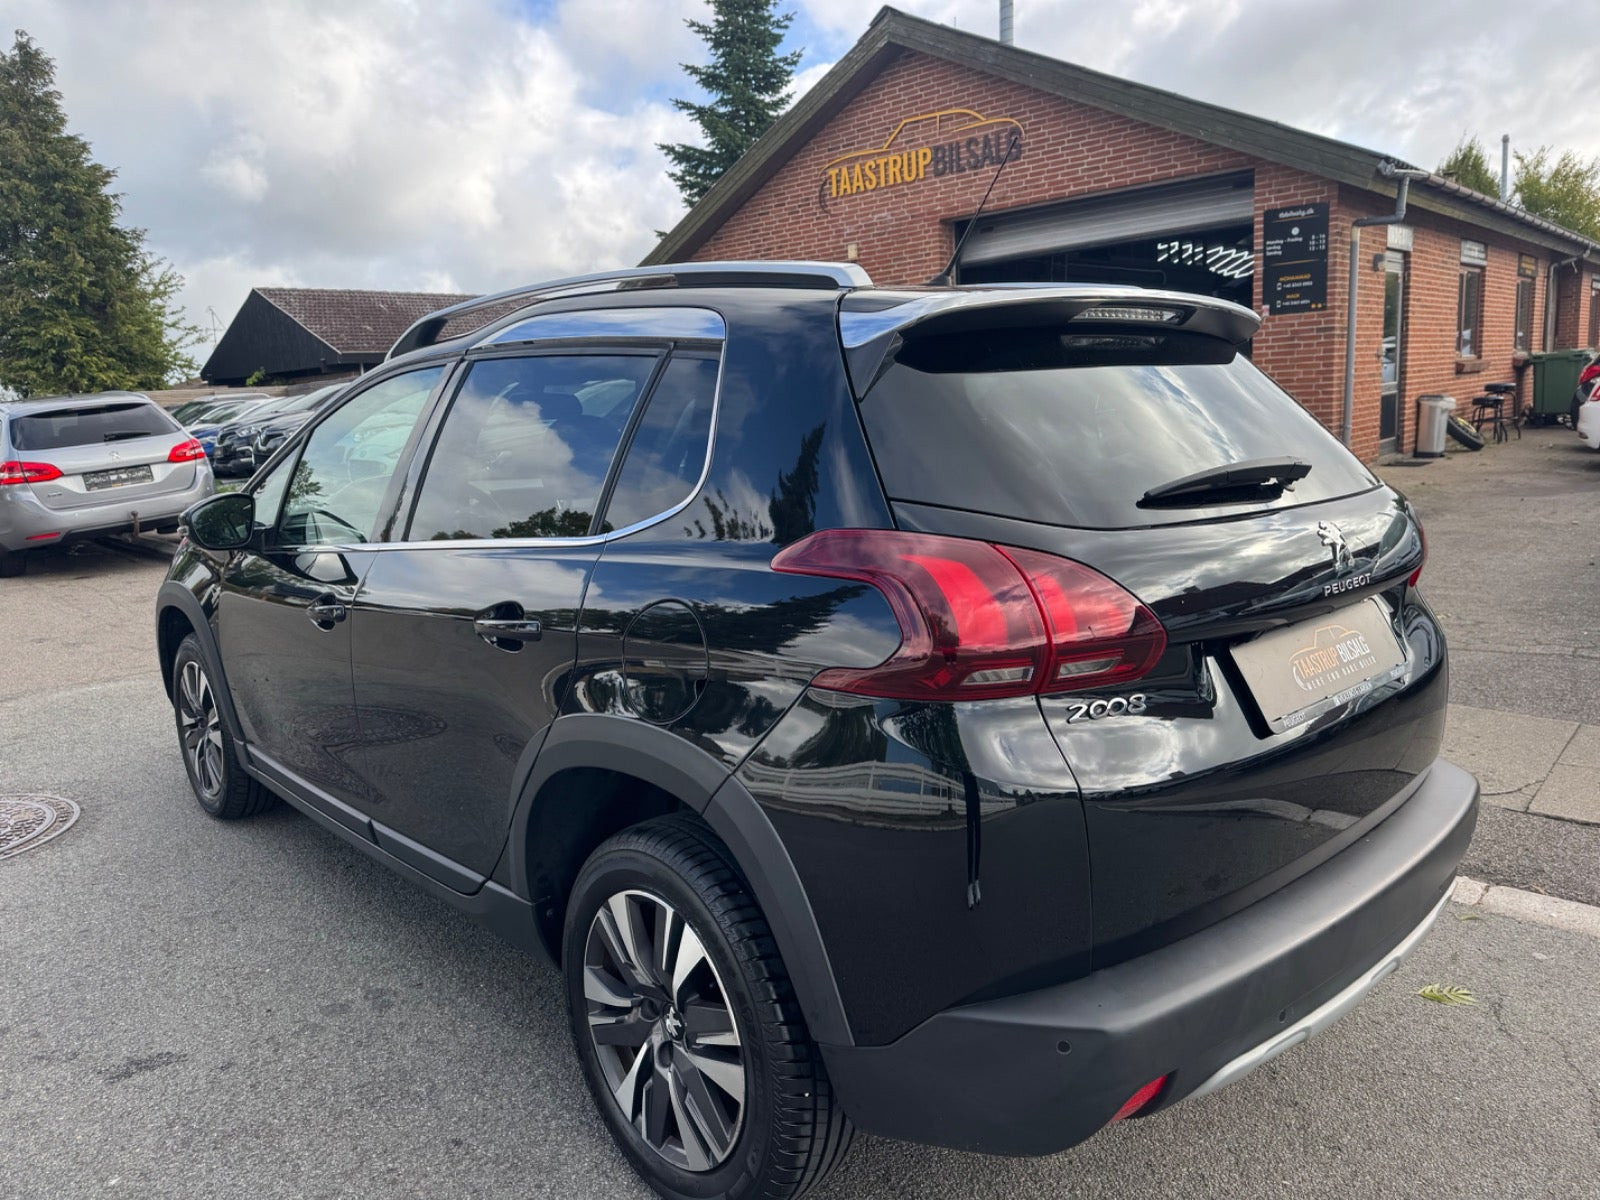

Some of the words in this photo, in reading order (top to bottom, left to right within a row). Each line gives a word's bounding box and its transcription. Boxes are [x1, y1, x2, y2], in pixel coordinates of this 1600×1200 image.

[828, 147, 932, 198] TAASTRUP
[932, 127, 1023, 177] BILSALG
[1324, 572, 1371, 597] PEUGEOT
[1294, 647, 1339, 679] TAASTRUP
[1336, 636, 1370, 662] BILSALG
[1067, 693, 1147, 723] 2008
